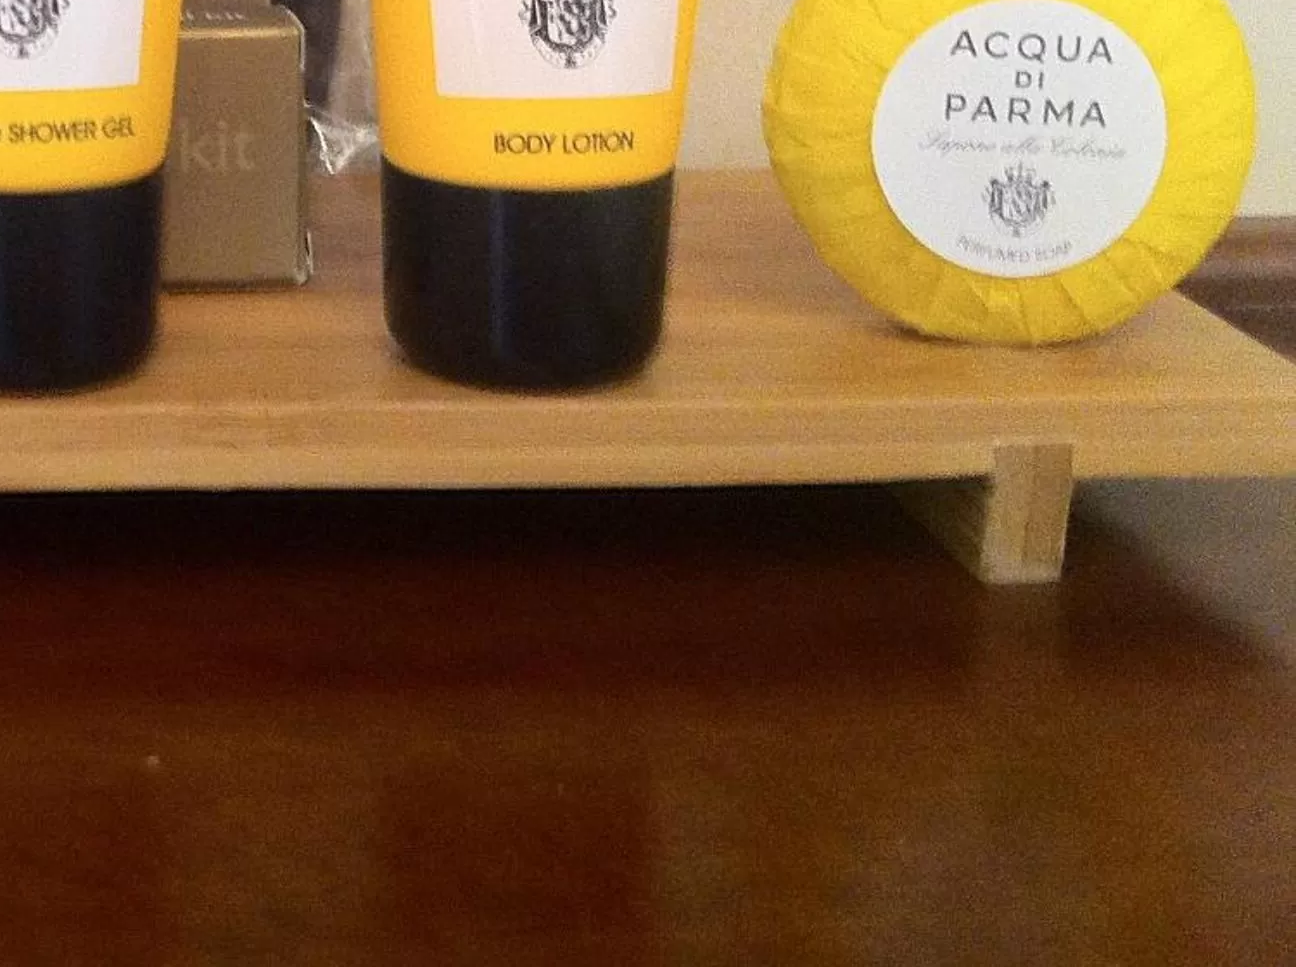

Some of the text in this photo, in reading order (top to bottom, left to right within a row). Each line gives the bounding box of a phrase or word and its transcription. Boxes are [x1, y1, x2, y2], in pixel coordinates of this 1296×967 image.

[950, 28, 1113, 65] ACQUA
[1014, 69, 1044, 89] DI
[945, 92, 1107, 128] PARMA
[7, 119, 99, 145] SHOWER
[101, 114, 136, 140] GEL
[180, 119, 255, 171] kit
[493, 130, 635, 154] BODY LOTION
